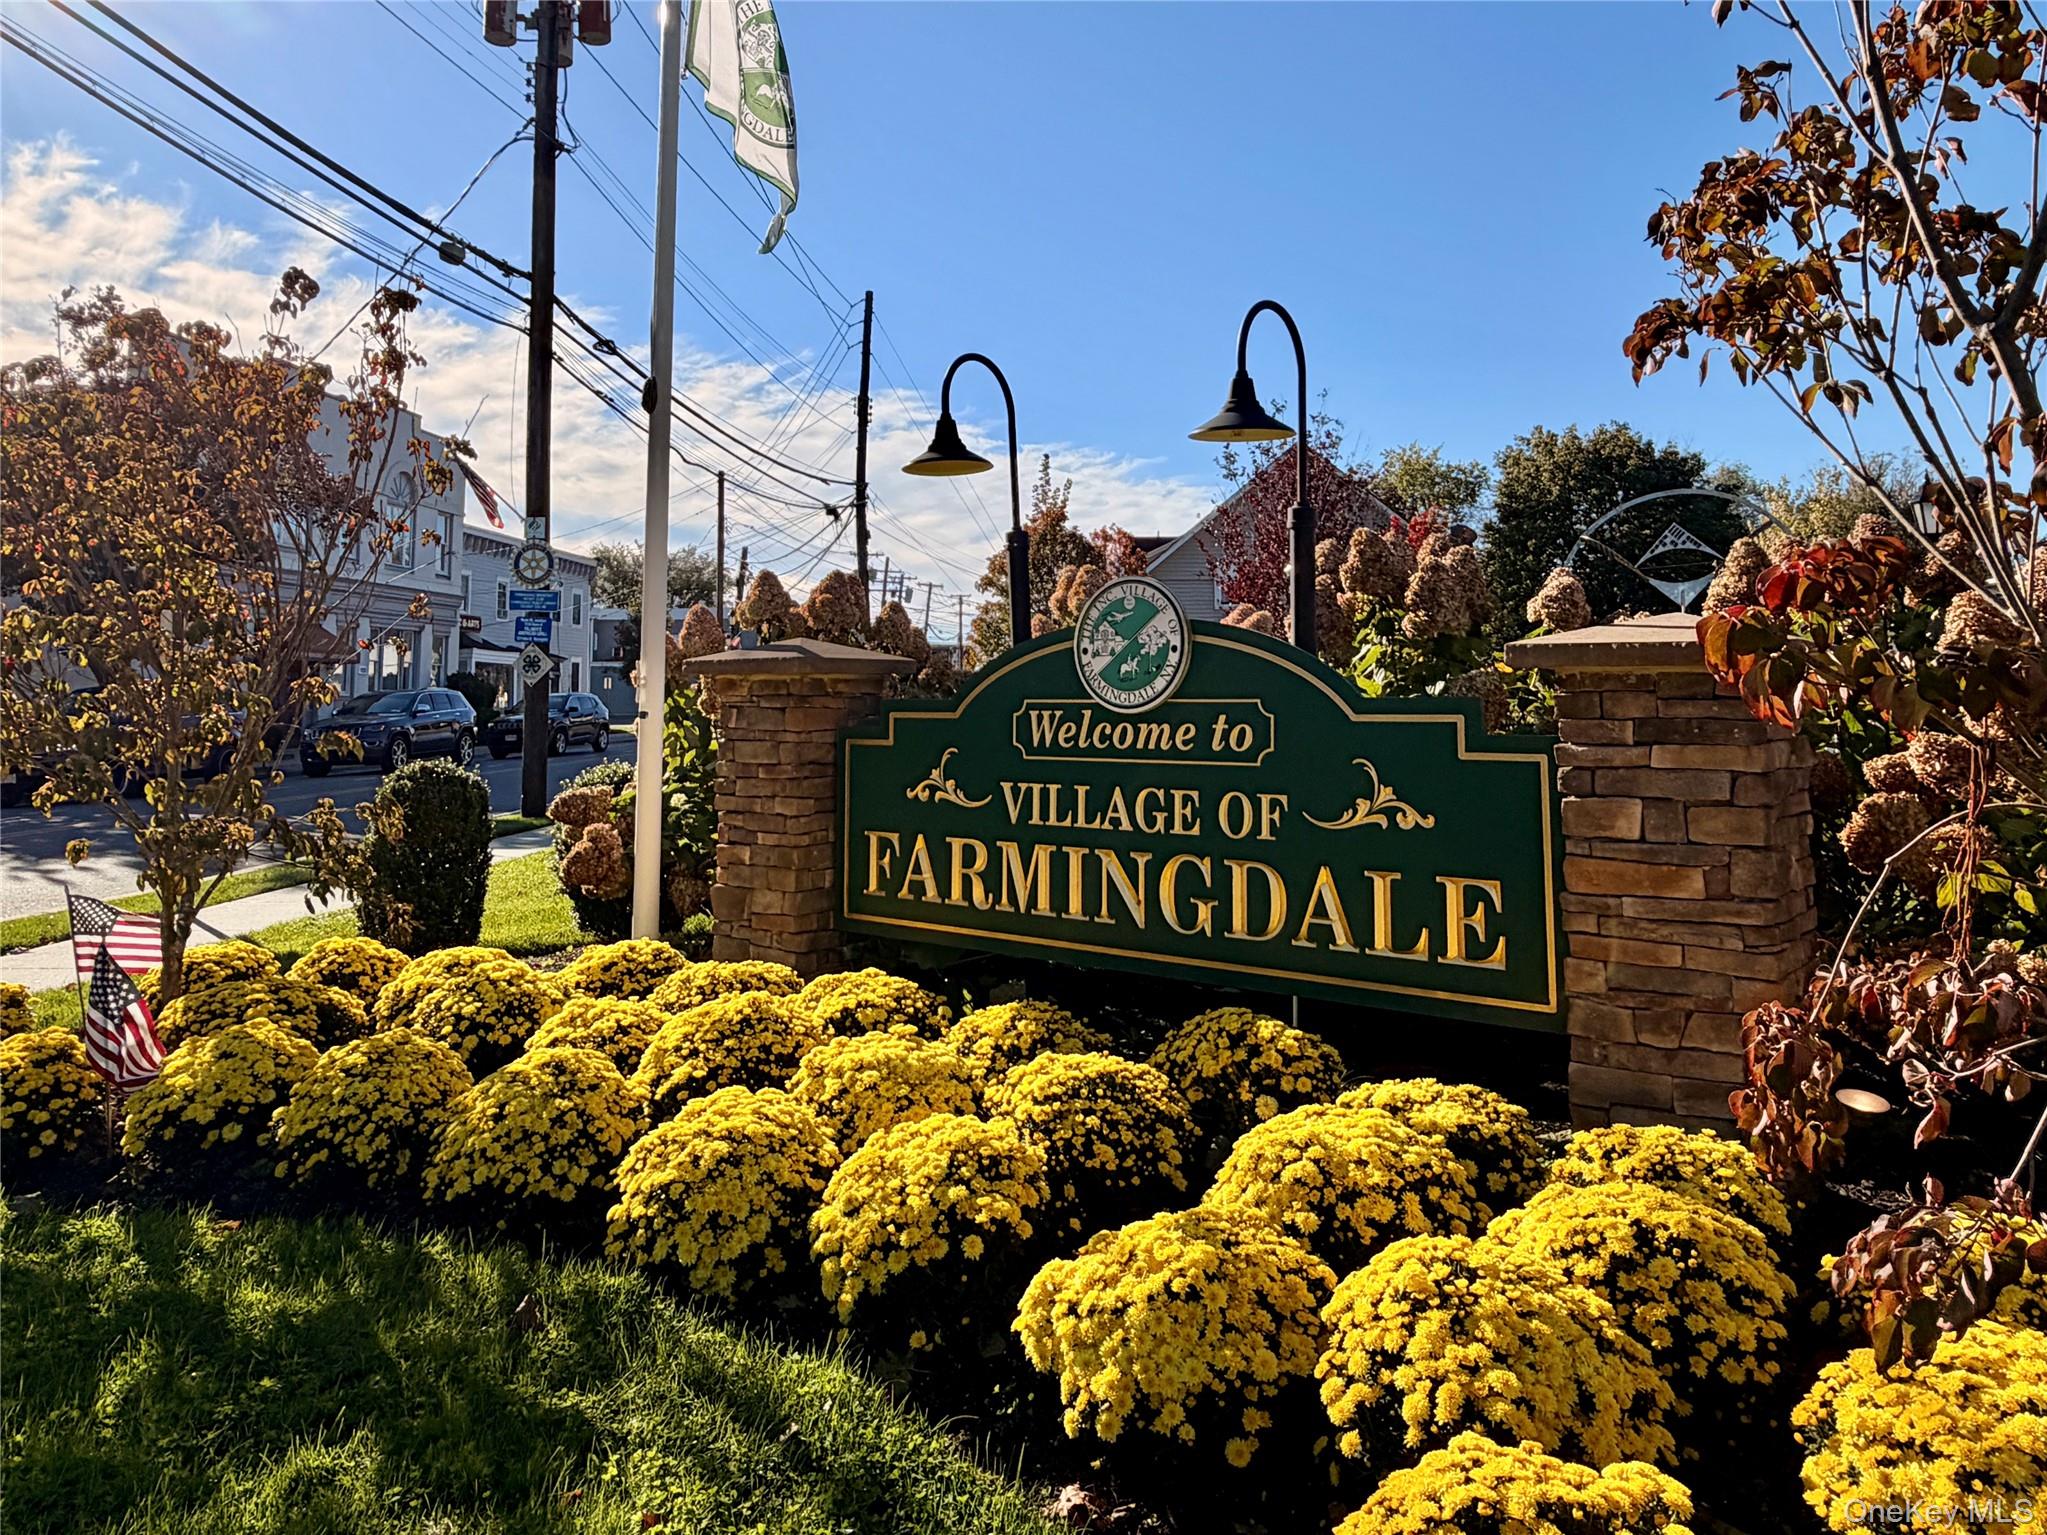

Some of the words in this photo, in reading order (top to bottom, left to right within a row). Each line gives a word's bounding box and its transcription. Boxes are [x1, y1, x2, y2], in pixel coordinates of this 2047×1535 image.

[1120, 585, 1171, 614] VILLAGE
[1167, 618, 1179, 636] OF
[1082, 661, 1158, 704] FARMINGDALE
[1028, 709, 1197, 751] Welcome
[1212, 714, 1254, 752] to
[999, 781, 1201, 836] VILLAGE
[1218, 791, 1289, 841] OF
[863, 830, 1507, 971] FARMINGDALE
